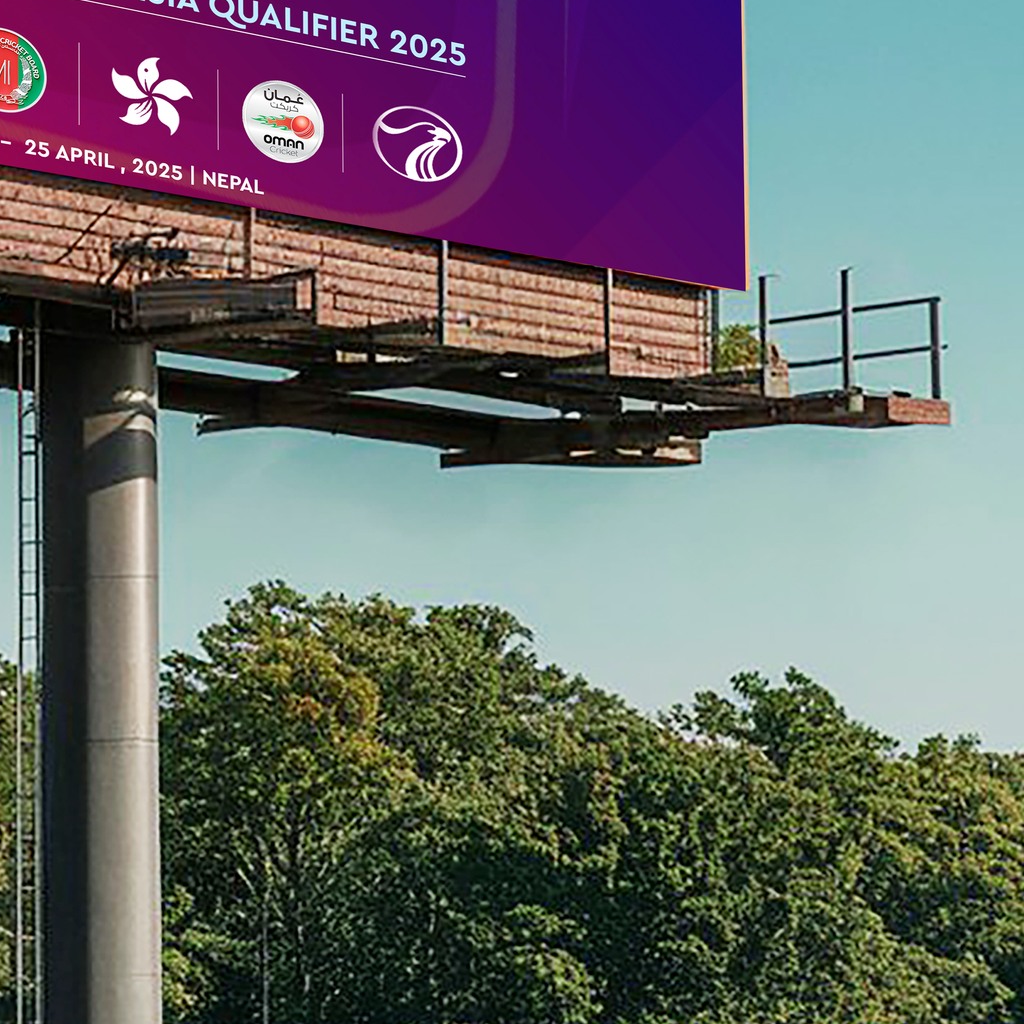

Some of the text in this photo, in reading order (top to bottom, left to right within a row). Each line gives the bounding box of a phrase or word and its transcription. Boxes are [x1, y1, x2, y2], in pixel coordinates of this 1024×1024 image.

[0, 37, 29, 57] CRICKET
[26, 55, 40, 79] BOARD
[390, 29, 466, 66] 2025
[24, 138, 50, 158] 25
[55, 144, 115, 169] APRIL
[132, 157, 183, 181] 2025
[203, 169, 265, 195] NEPAL
[269, 145, 299, 157] Cricket
